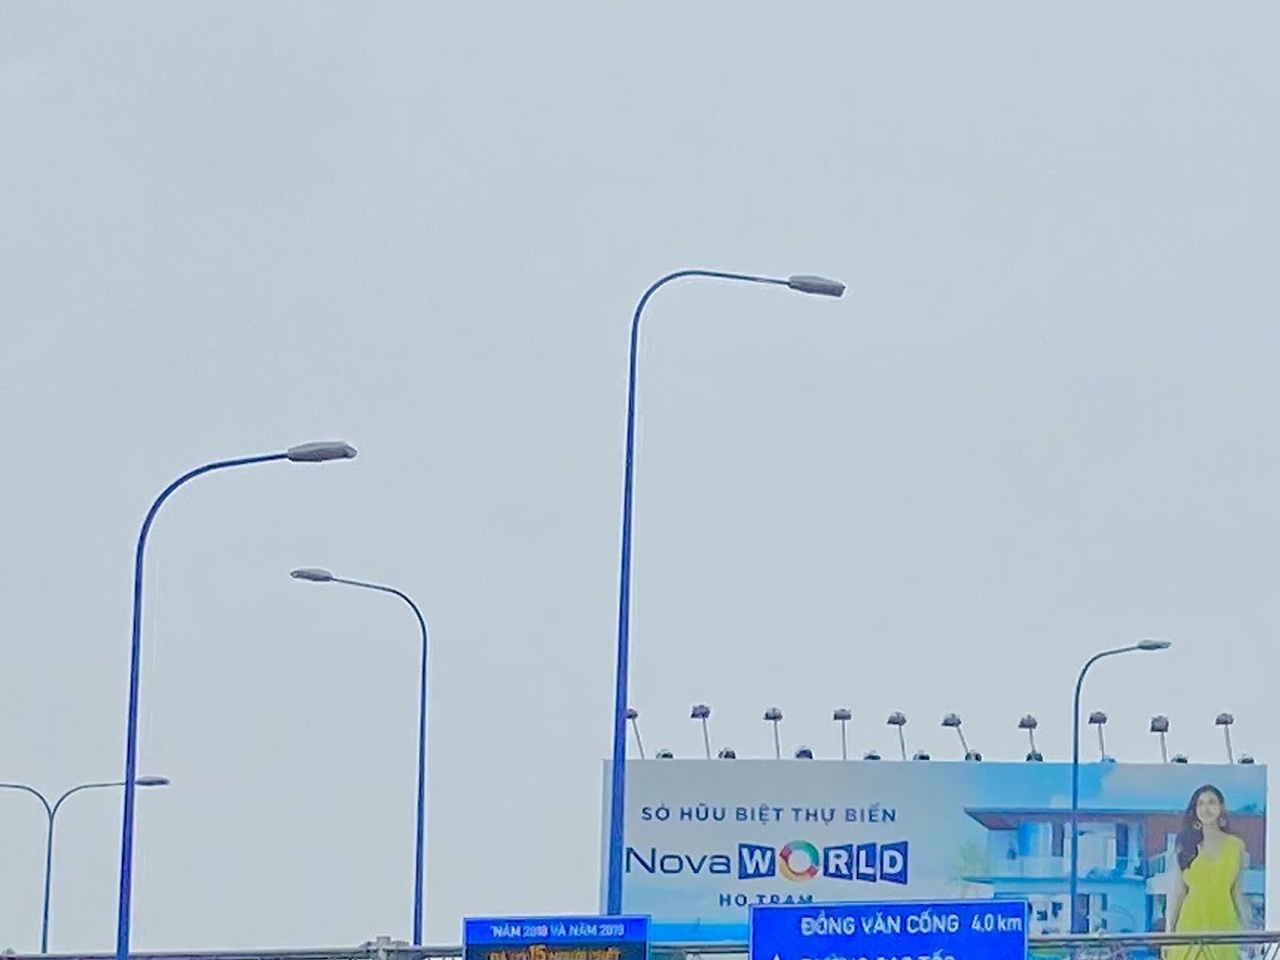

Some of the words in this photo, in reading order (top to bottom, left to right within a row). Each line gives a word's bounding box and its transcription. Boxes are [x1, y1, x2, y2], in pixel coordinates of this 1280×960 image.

[735, 803, 785, 825] BIỆT
[860, 911, 901, 935] VĂN
[906, 906, 960, 934] CỐNG
[997, 913, 1023, 932] km
